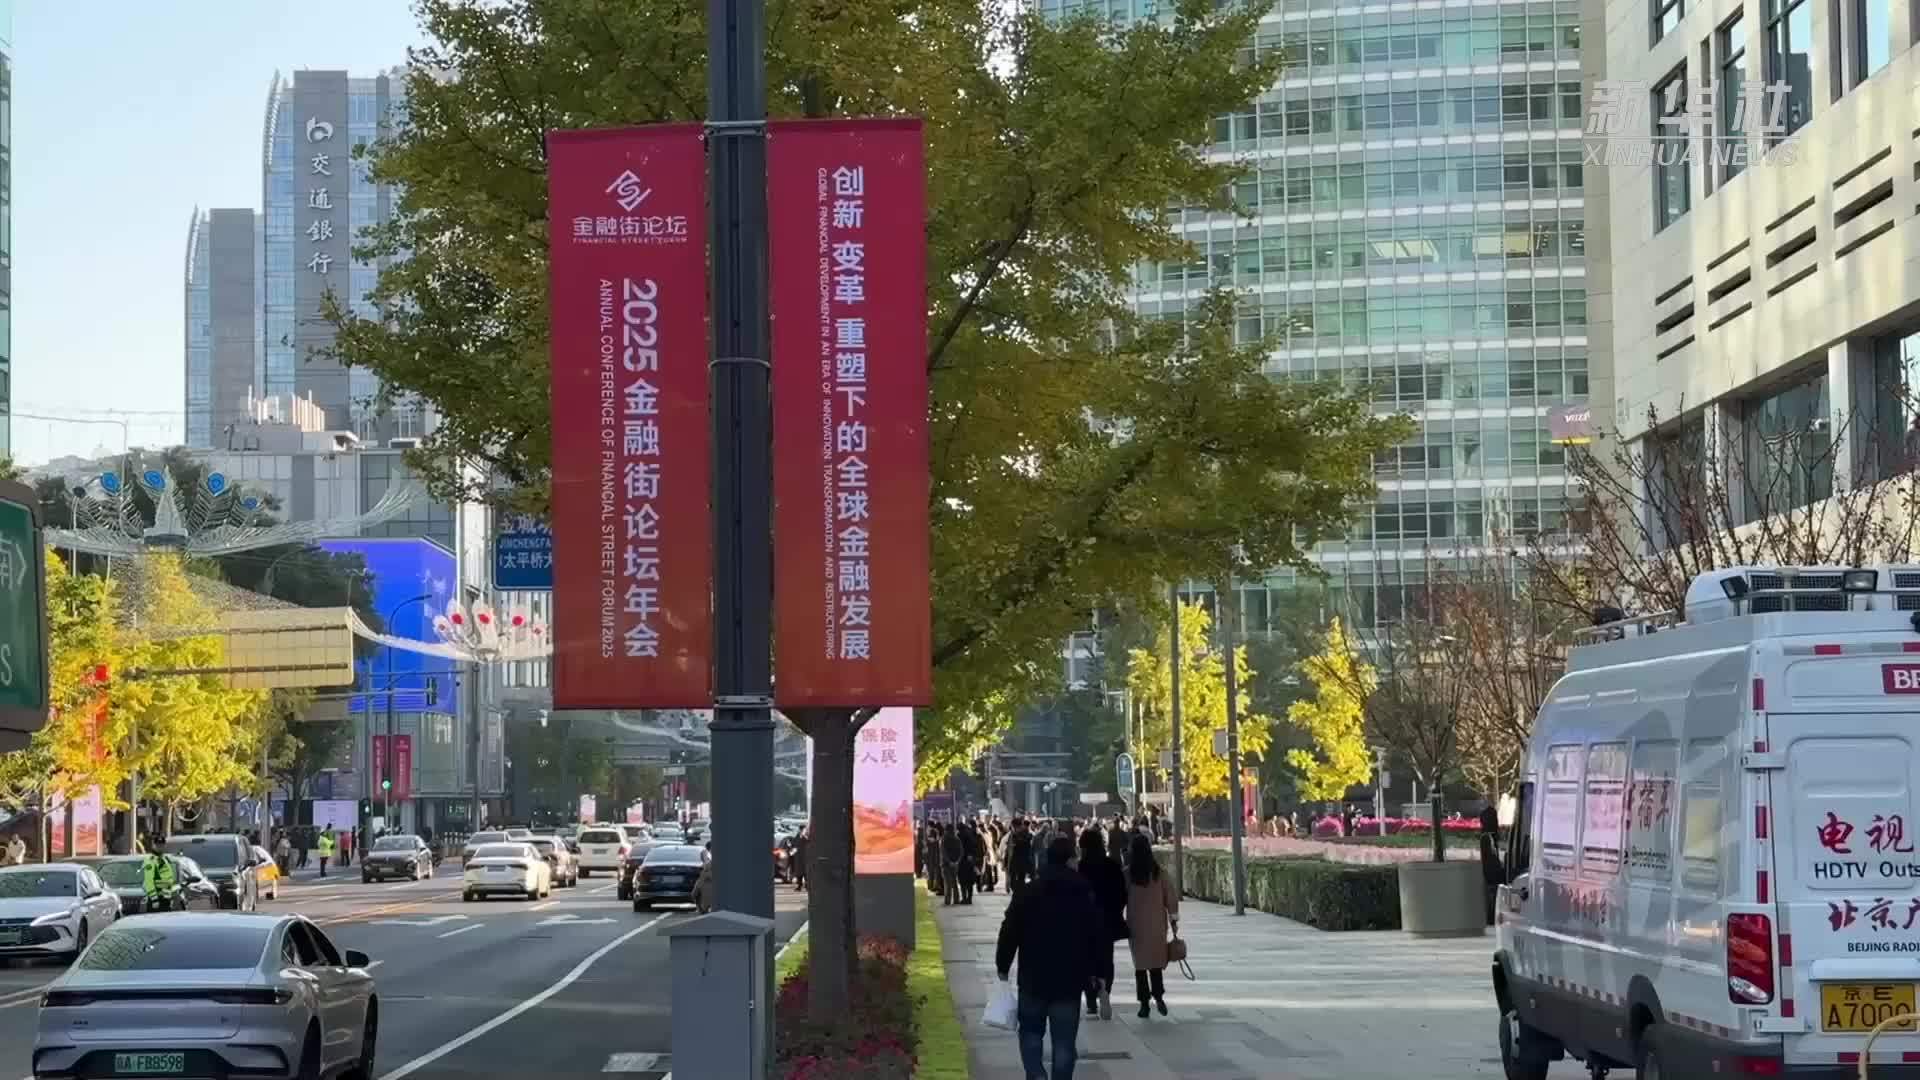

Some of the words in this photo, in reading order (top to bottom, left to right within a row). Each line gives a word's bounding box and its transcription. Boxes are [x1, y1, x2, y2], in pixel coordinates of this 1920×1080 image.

[818, 167, 827, 202] GLOBAL
[832, 165, 865, 228] 创新
[572, 215, 688, 236] 金融街论坛
[819, 205, 829, 254] FINANCIAL
[820, 257, 830, 323] DEVELOPMENT
[832, 240, 865, 305] 变革
[600, 278, 613, 332] ANNUAL
[821, 325, 830, 337] IN
[822, 341, 831, 356] AN
[601, 335, 615, 426] CONFERENCE
[822, 359, 831, 378] ERA
[822, 382, 832, 395] OF
[602, 431, 615, 447] OF
[823, 398, 832, 460] INNOVATION
[602, 450, 616, 521] FINANCIAL
[823, 464, 834, 553] TRANSFORMATION
[835, 318, 872, 661] 重塑下的全球金融发展
[602, 524, 615, 577] STREET
[824, 556, 834, 578] AND
[825, 583, 836, 660] RESTRUCTURING
[1816, 811, 1915, 854] 电视
[1814, 861, 1867, 879] HDTV
[1847, 942, 1890, 952] BEIJING
